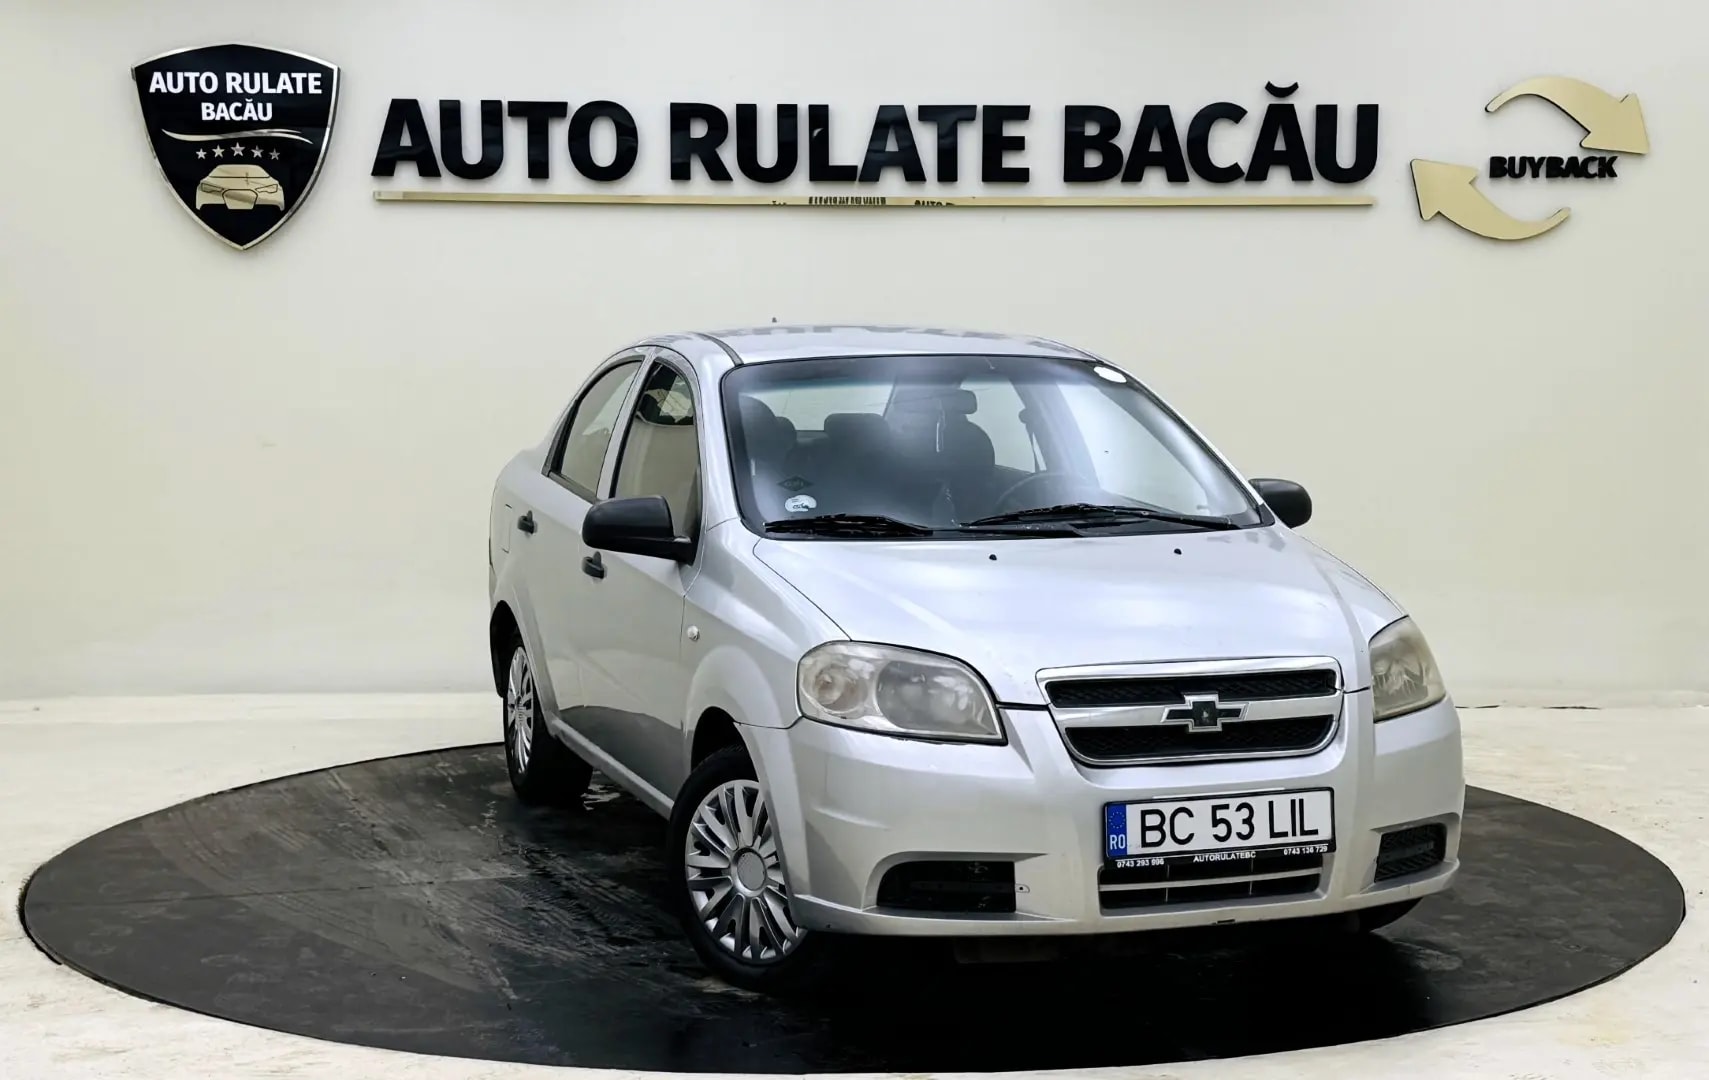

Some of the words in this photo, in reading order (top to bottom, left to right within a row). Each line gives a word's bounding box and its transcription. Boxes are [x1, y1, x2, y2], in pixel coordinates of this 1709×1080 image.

[149, 72, 218, 94] AUTO
[225, 72, 322, 94] RULATE
[201, 98, 273, 121] BACĂU
[371, 99, 639, 183] AUTO
[670, 103, 1030, 185] RULATE
[1064, 82, 1379, 185] BACĂU
[1489, 156, 1618, 178] BUYBACK
[1141, 807, 1195, 848] BC
[1211, 802, 1255, 842] 53
[1268, 798, 1319, 839] LIL
[1109, 834, 1126, 850] RO
[1283, 847, 1300, 856] 0743
[1117, 860, 1135, 869] 0743
[1193, 851, 1257, 863] AUTORULATEBC
